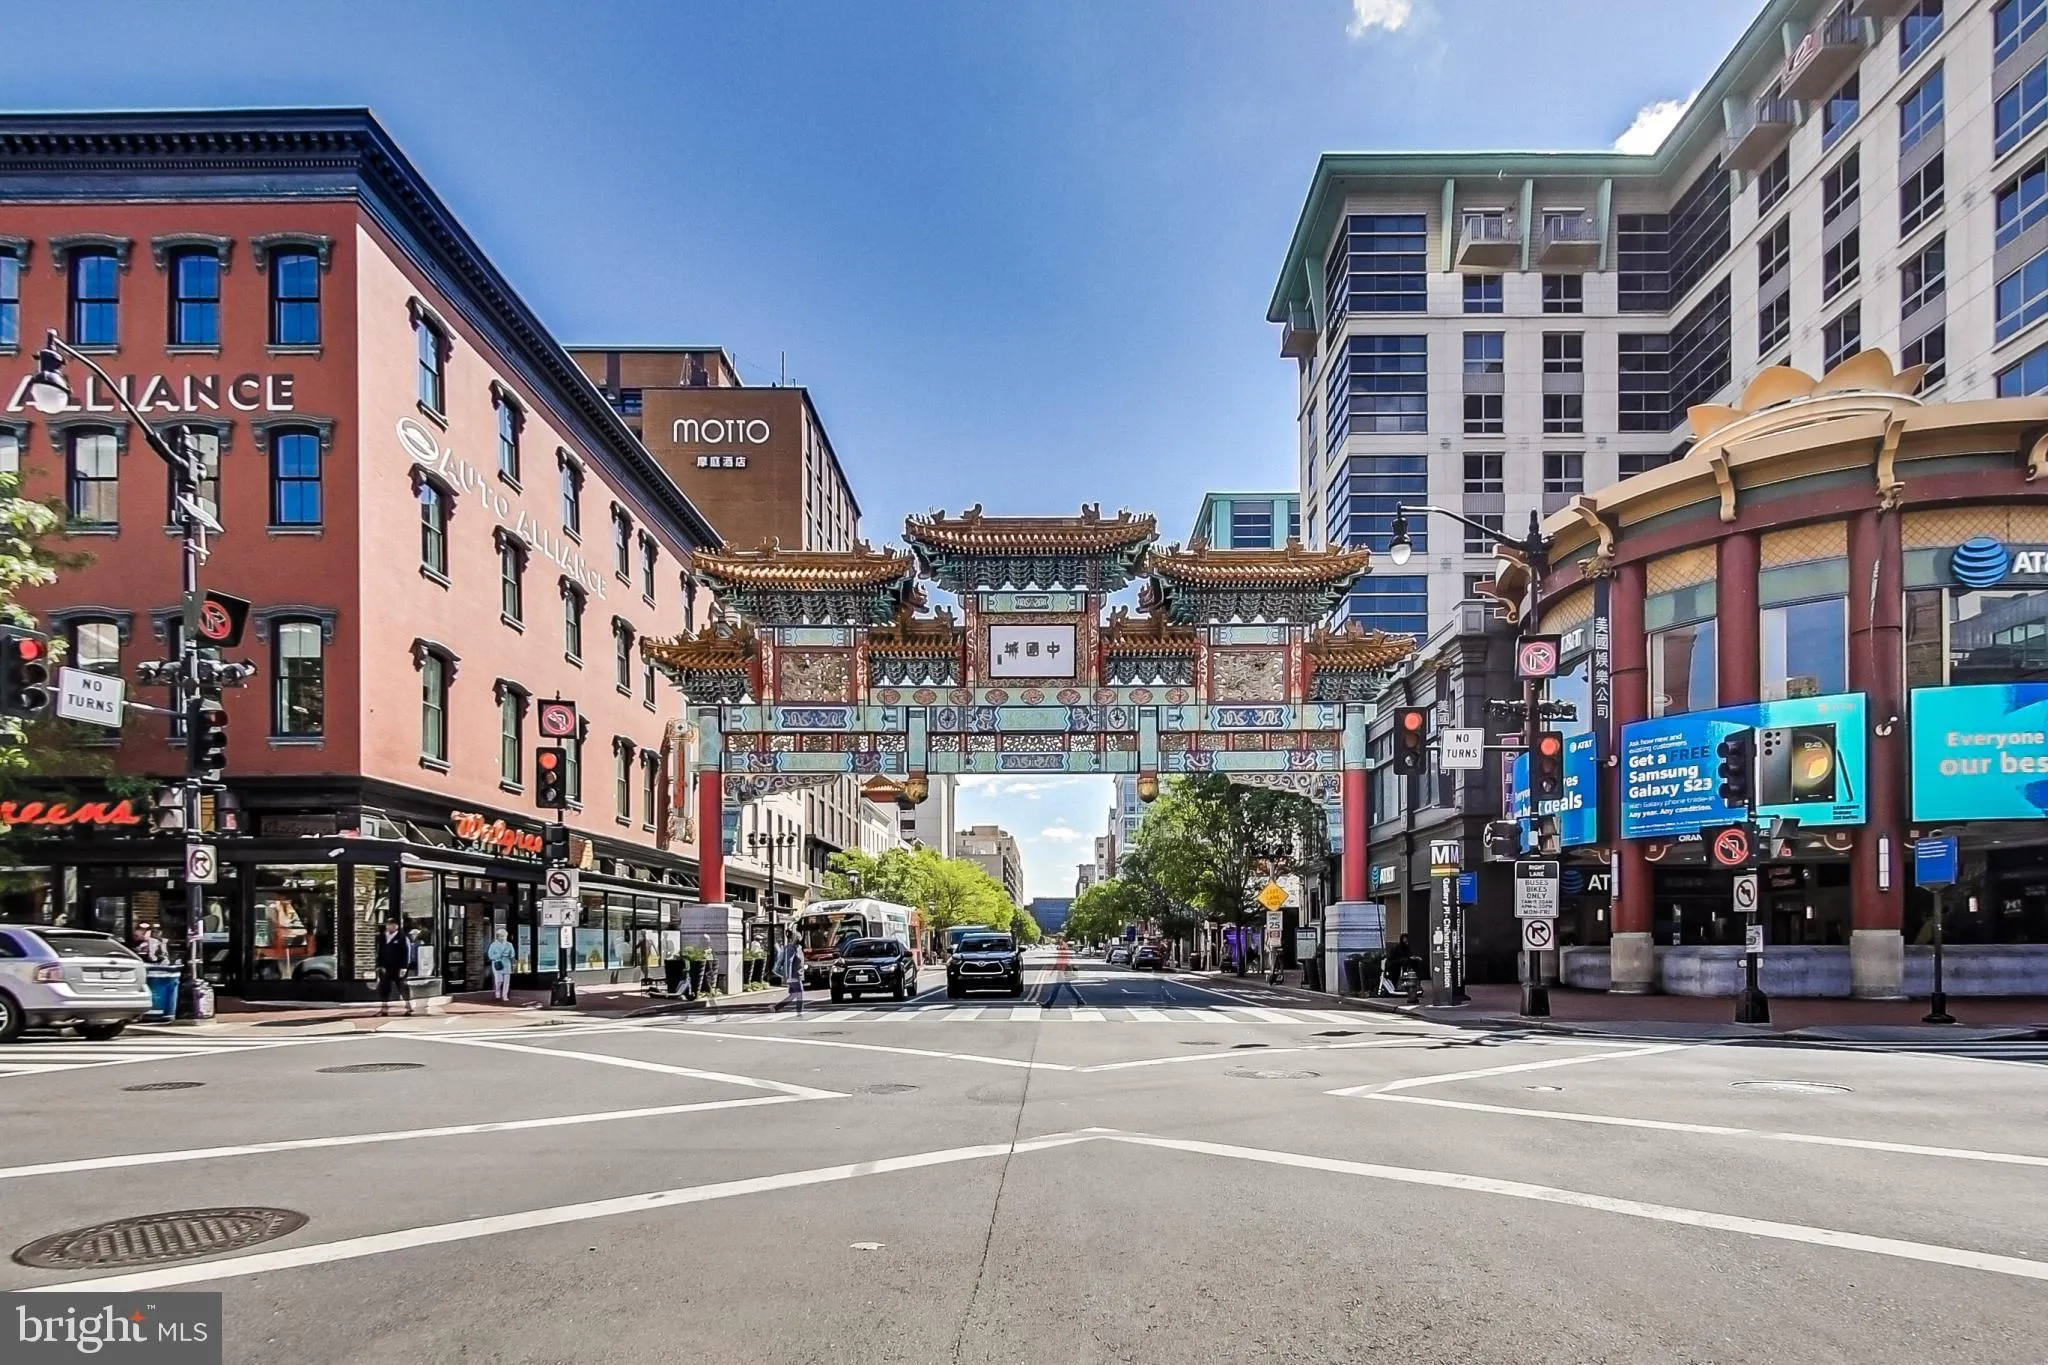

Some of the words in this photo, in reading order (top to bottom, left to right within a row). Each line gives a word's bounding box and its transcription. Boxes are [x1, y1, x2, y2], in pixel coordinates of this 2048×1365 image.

[673, 419, 770, 444] MOTTO
[438, 447, 509, 520] AUTO
[516, 510, 606, 600] ALLIANCE
[2011, 551, 2048, 574] AT
[1595, 616, 1609, 719] 美國娛樂公司
[82, 679, 103, 692] NO
[67, 693, 113, 713] TURNS
[1455, 733, 1470, 743] NO
[1577, 739, 1594, 750] AT&T
[1947, 731, 2045, 750] Everyone
[1447, 749, 1478, 758] TURNS
[1629, 753, 1654, 769] Get
[1657, 753, 1667, 764] a
[1669, 745, 1710, 762] FREE
[1629, 765, 1699, 784] Samsung
[1940, 757, 1992, 776] our
[1629, 782, 1680, 799] Galaxy
[1683, 777, 1713, 793] S23
[1660, 807, 1673, 816] Any
[451, 810, 543, 856] Walgree
[1431, 845, 1450, 865] M
[1450, 845, 1459, 864] M
[1442, 877, 1451, 905] Gallery
[1269, 921, 1281, 929] 25
[1443, 960, 1452, 988] Station
